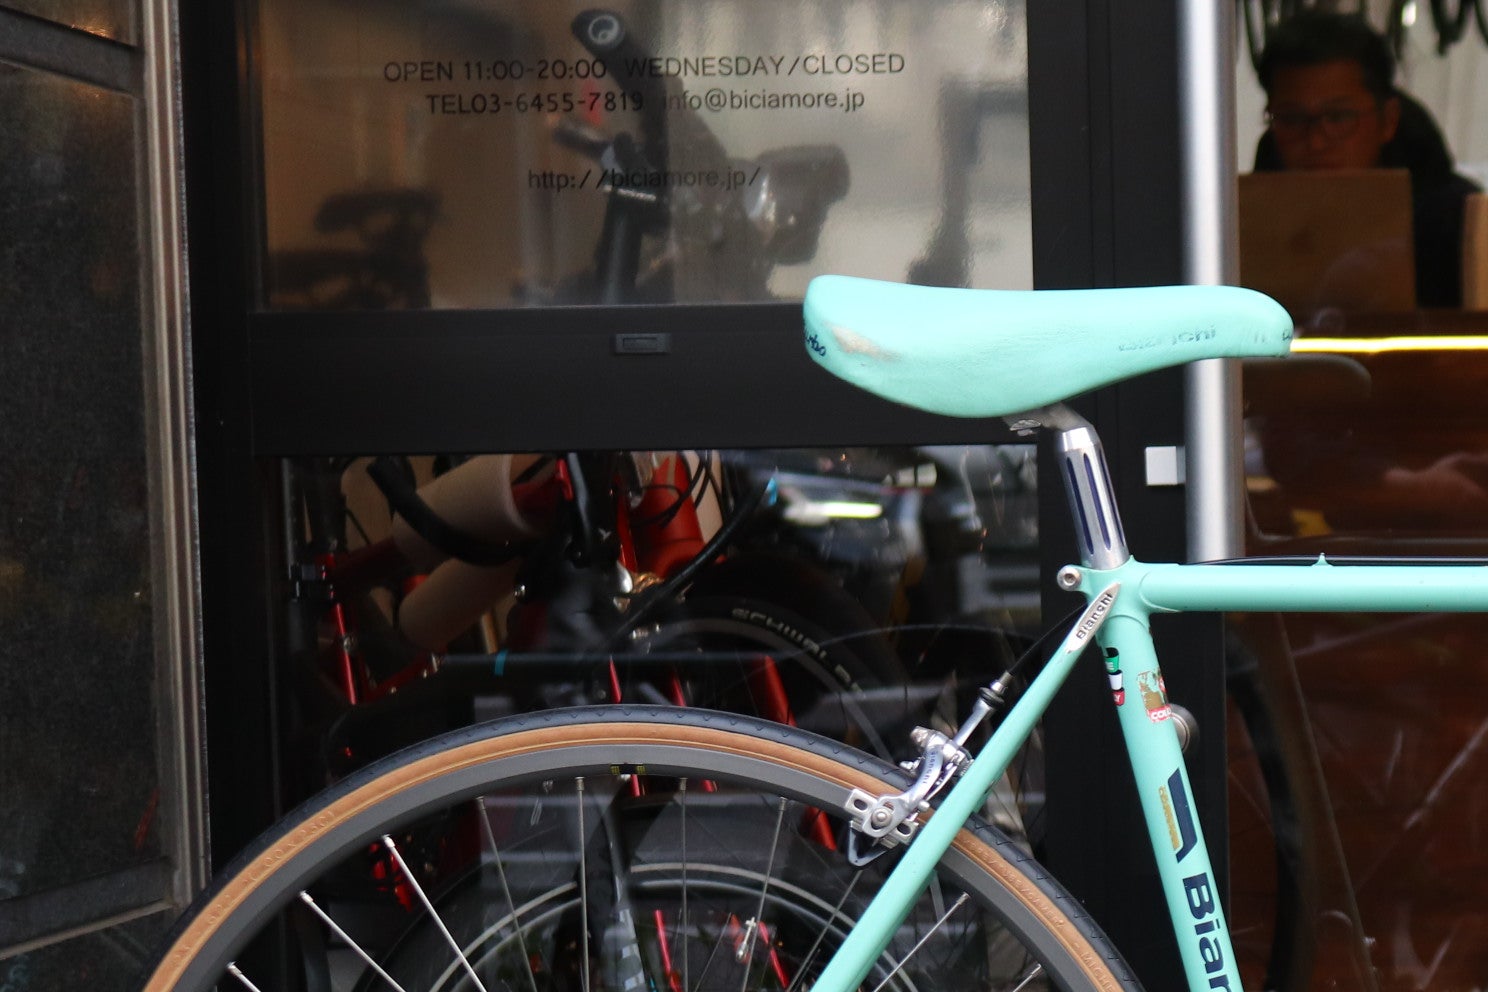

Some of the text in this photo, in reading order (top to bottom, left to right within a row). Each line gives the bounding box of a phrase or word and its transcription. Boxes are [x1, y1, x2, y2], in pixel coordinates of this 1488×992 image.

[384, 54, 905, 82] OPEN 11:00-20:00 WEDNESDAY/CLOSED
[663, 88, 865, 113] info@biciamore.jp
[1075, 591, 1114, 641] Bianchi
